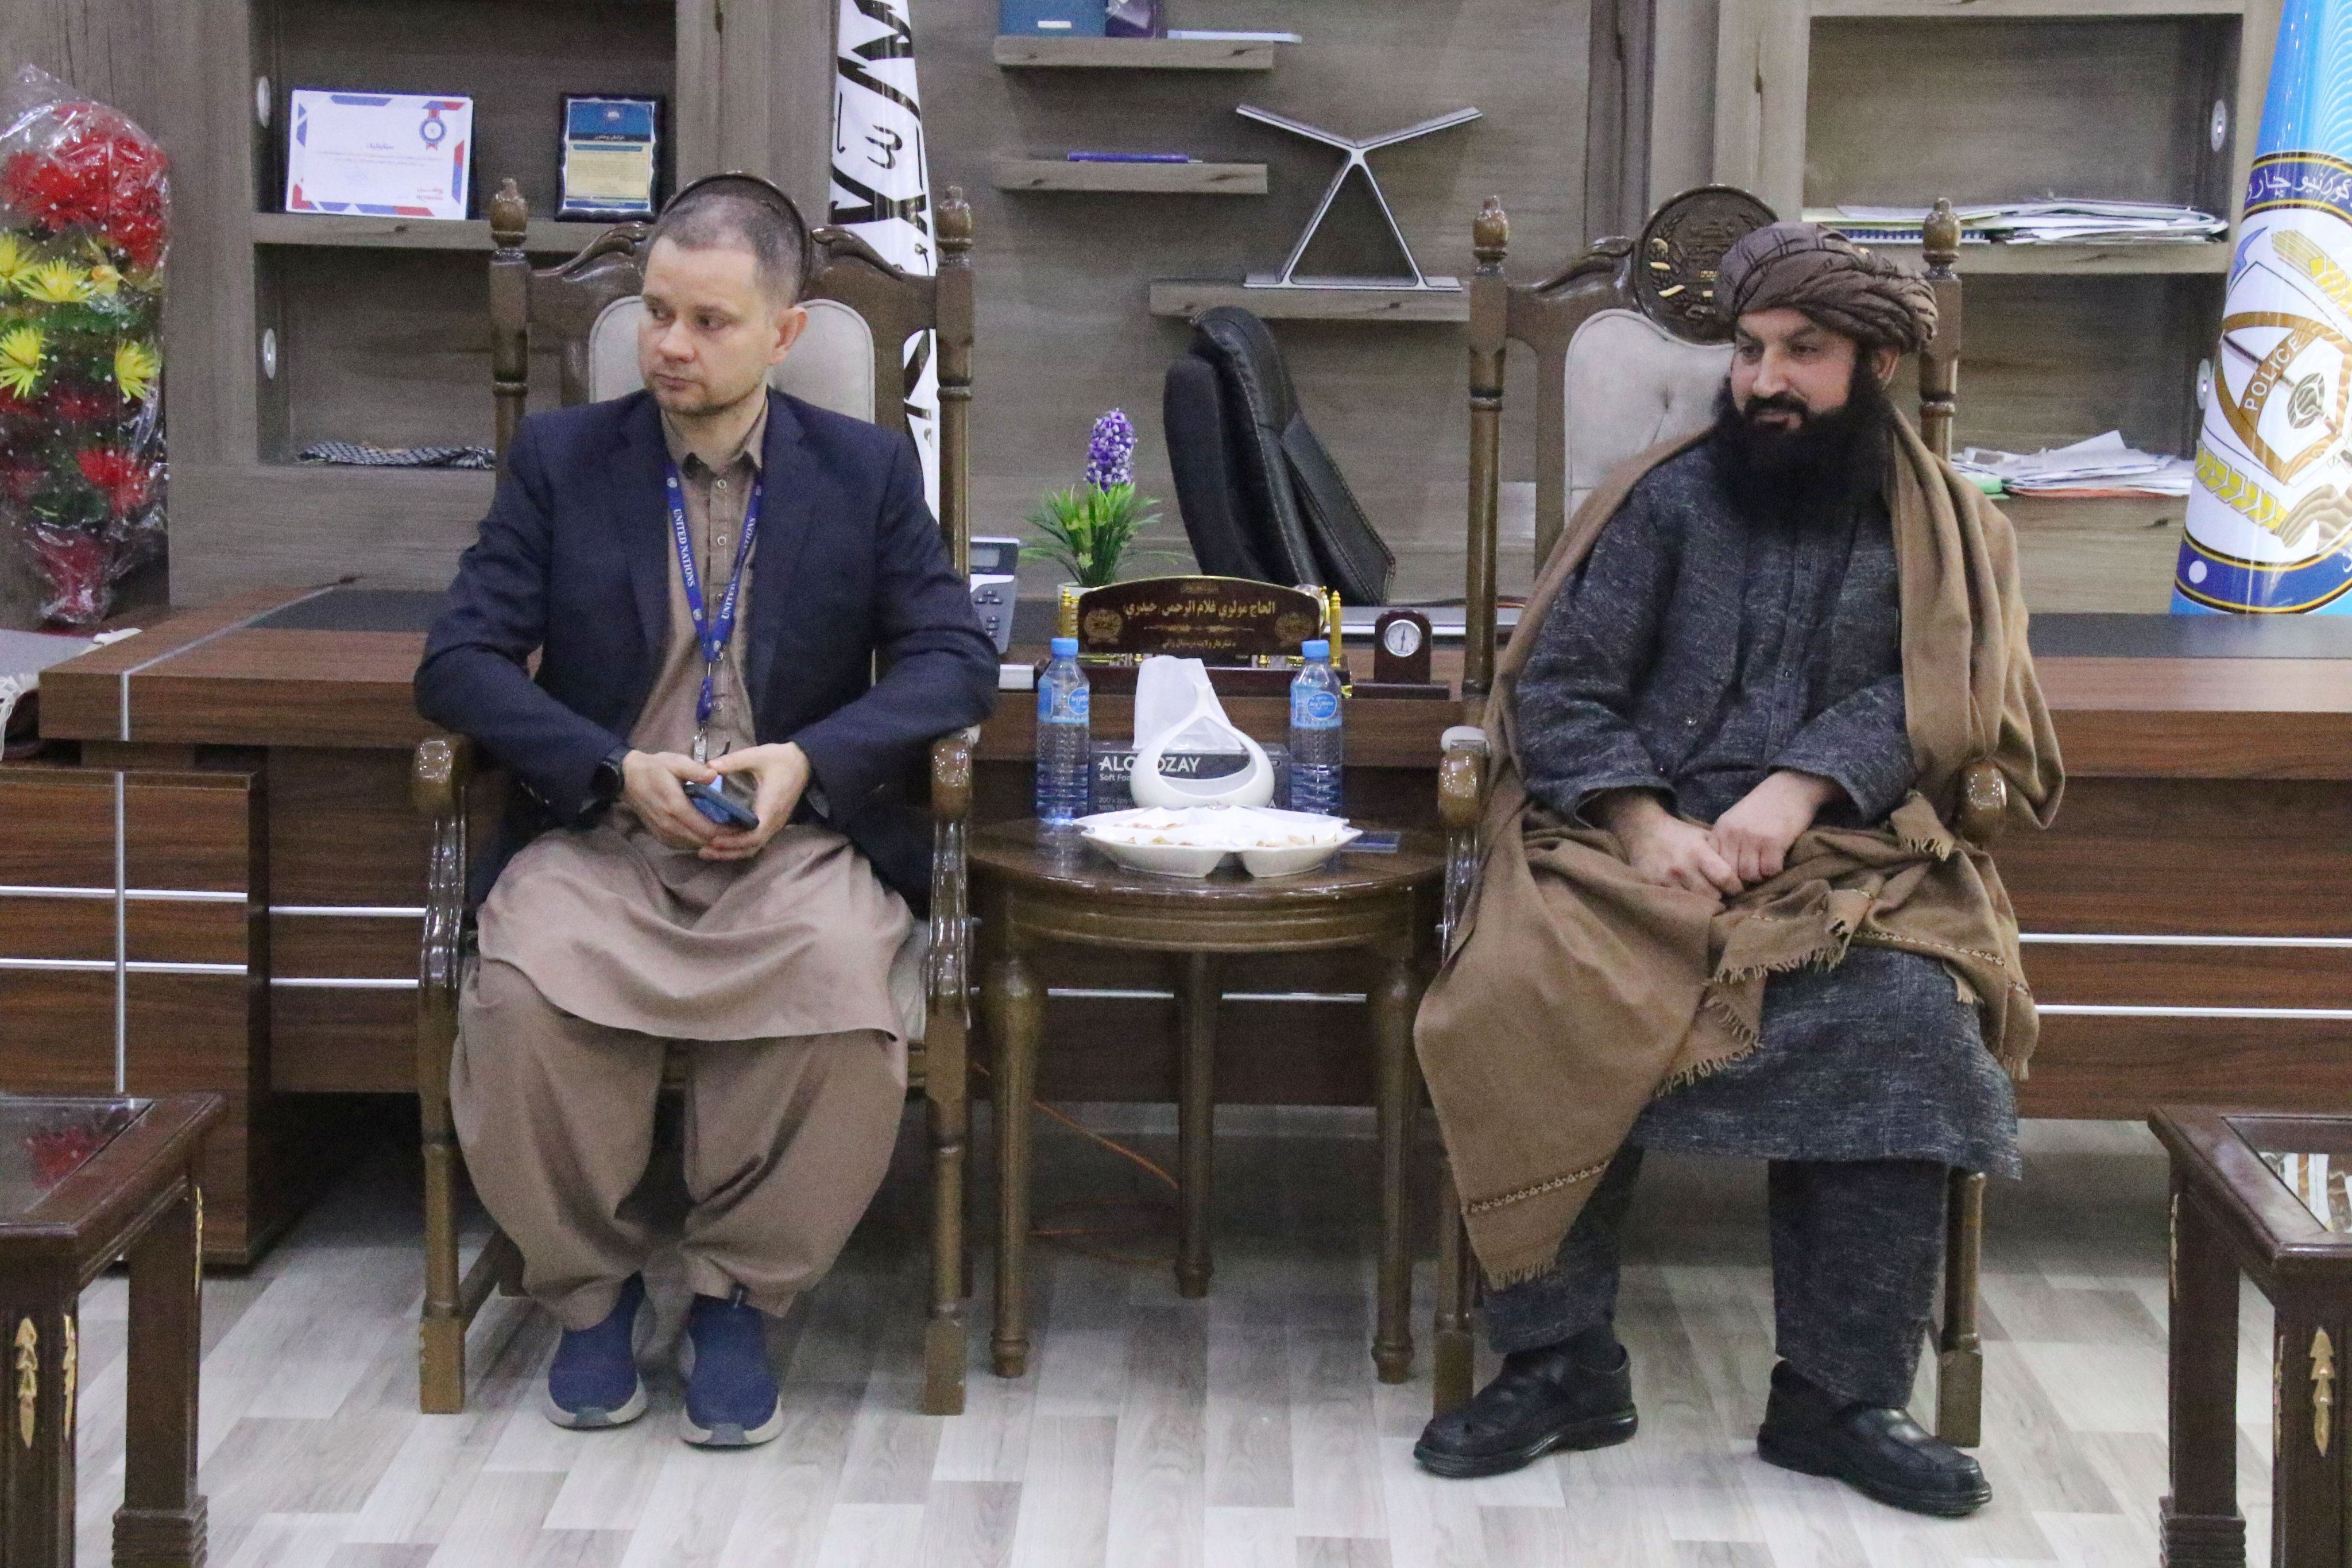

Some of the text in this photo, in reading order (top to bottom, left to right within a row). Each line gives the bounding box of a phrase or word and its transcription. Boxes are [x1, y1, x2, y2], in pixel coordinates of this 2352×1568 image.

[2243, 335, 2301, 411] POLICE
[673, 508, 696, 588] UNITED NATIONS
[1098, 756, 1200, 772] ALOOZAY
[1099, 773, 1116, 781] Soft
